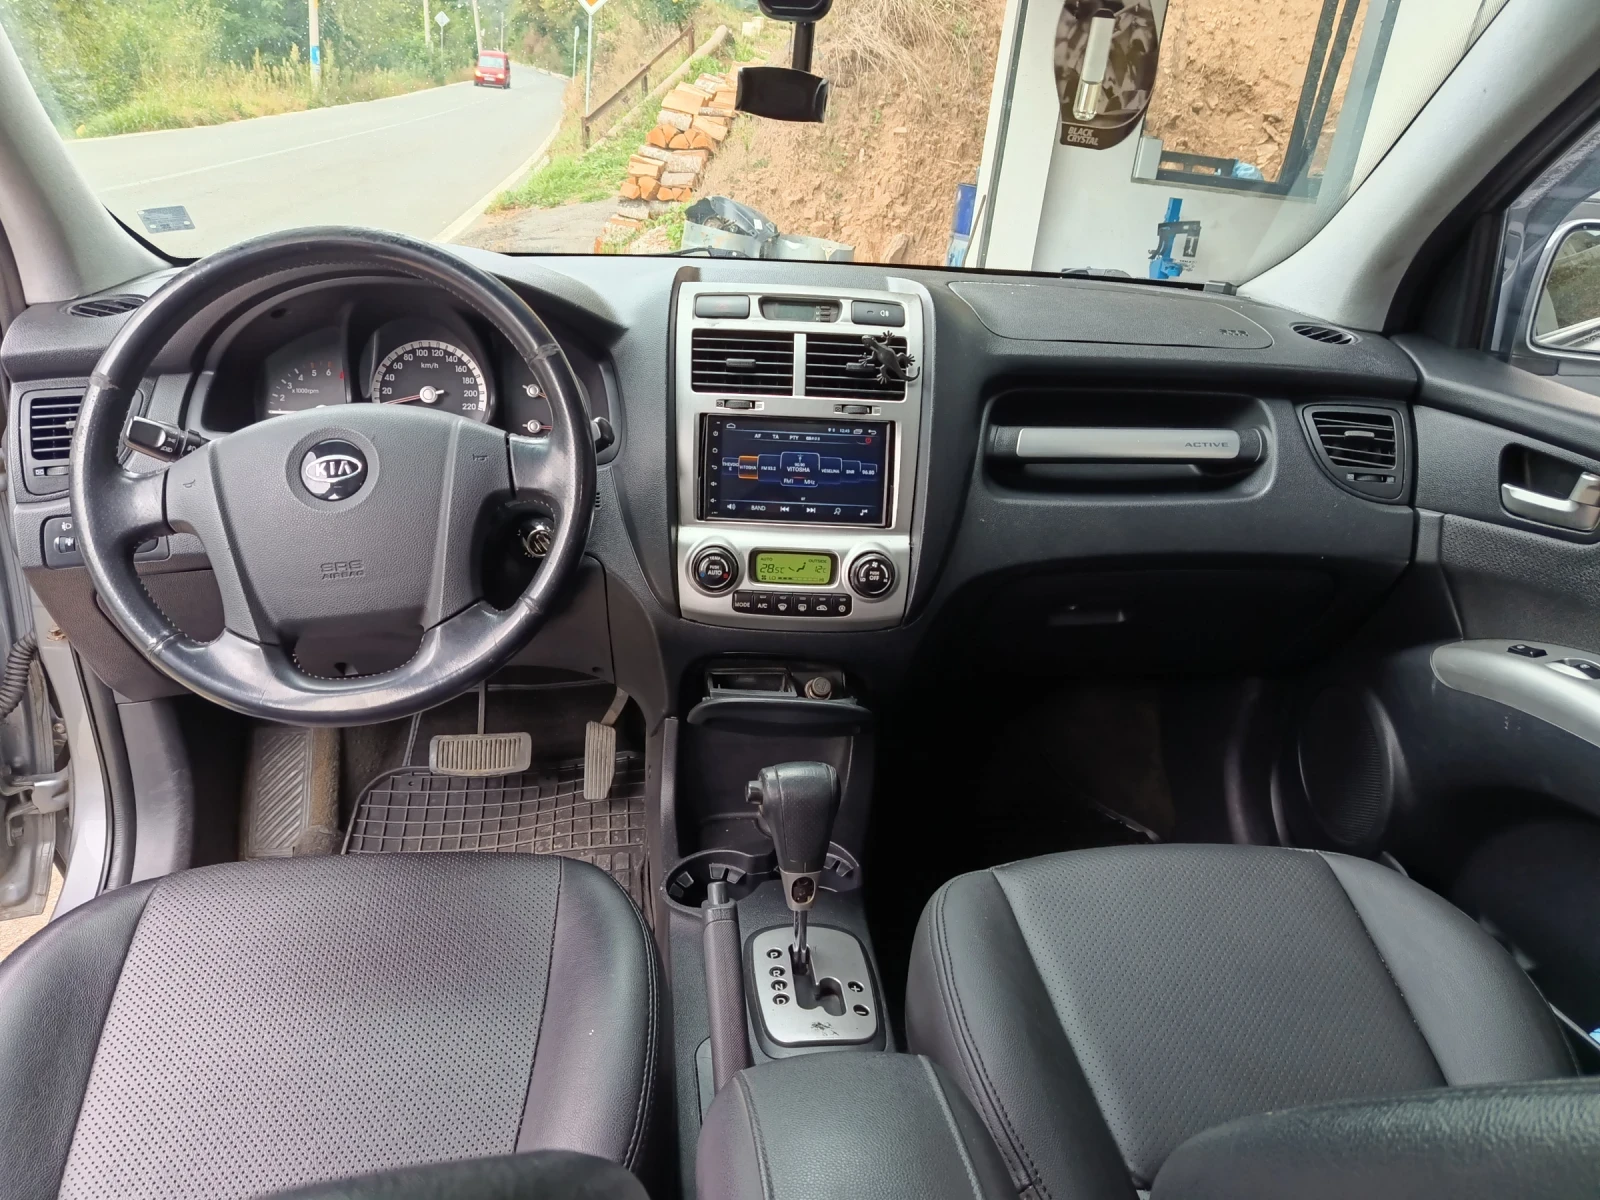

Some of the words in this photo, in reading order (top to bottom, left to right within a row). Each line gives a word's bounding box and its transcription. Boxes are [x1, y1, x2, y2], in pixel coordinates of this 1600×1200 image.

[1067, 126, 1094, 137] BLACK
[1066, 134, 1099, 146] CRYSTAL
[403, 353, 413, 361] 80
[416, 349, 428, 357] 100
[431, 349, 444, 357] 120
[445, 355, 458, 363] 140
[392, 362, 403, 370] 60
[455, 365, 467, 373] 160
[311, 369, 317, 377] 5
[325, 368, 332, 377] 6
[384, 373, 395, 381] 40
[462, 377, 475, 385] 180
[382, 387, 392, 395] 20
[463, 390, 478, 398] 200
[462, 403, 477, 411] 220
[315, 461, 352, 476] KIA
[774, 983, 784, 991] N
[776, 997, 786, 1005] D
